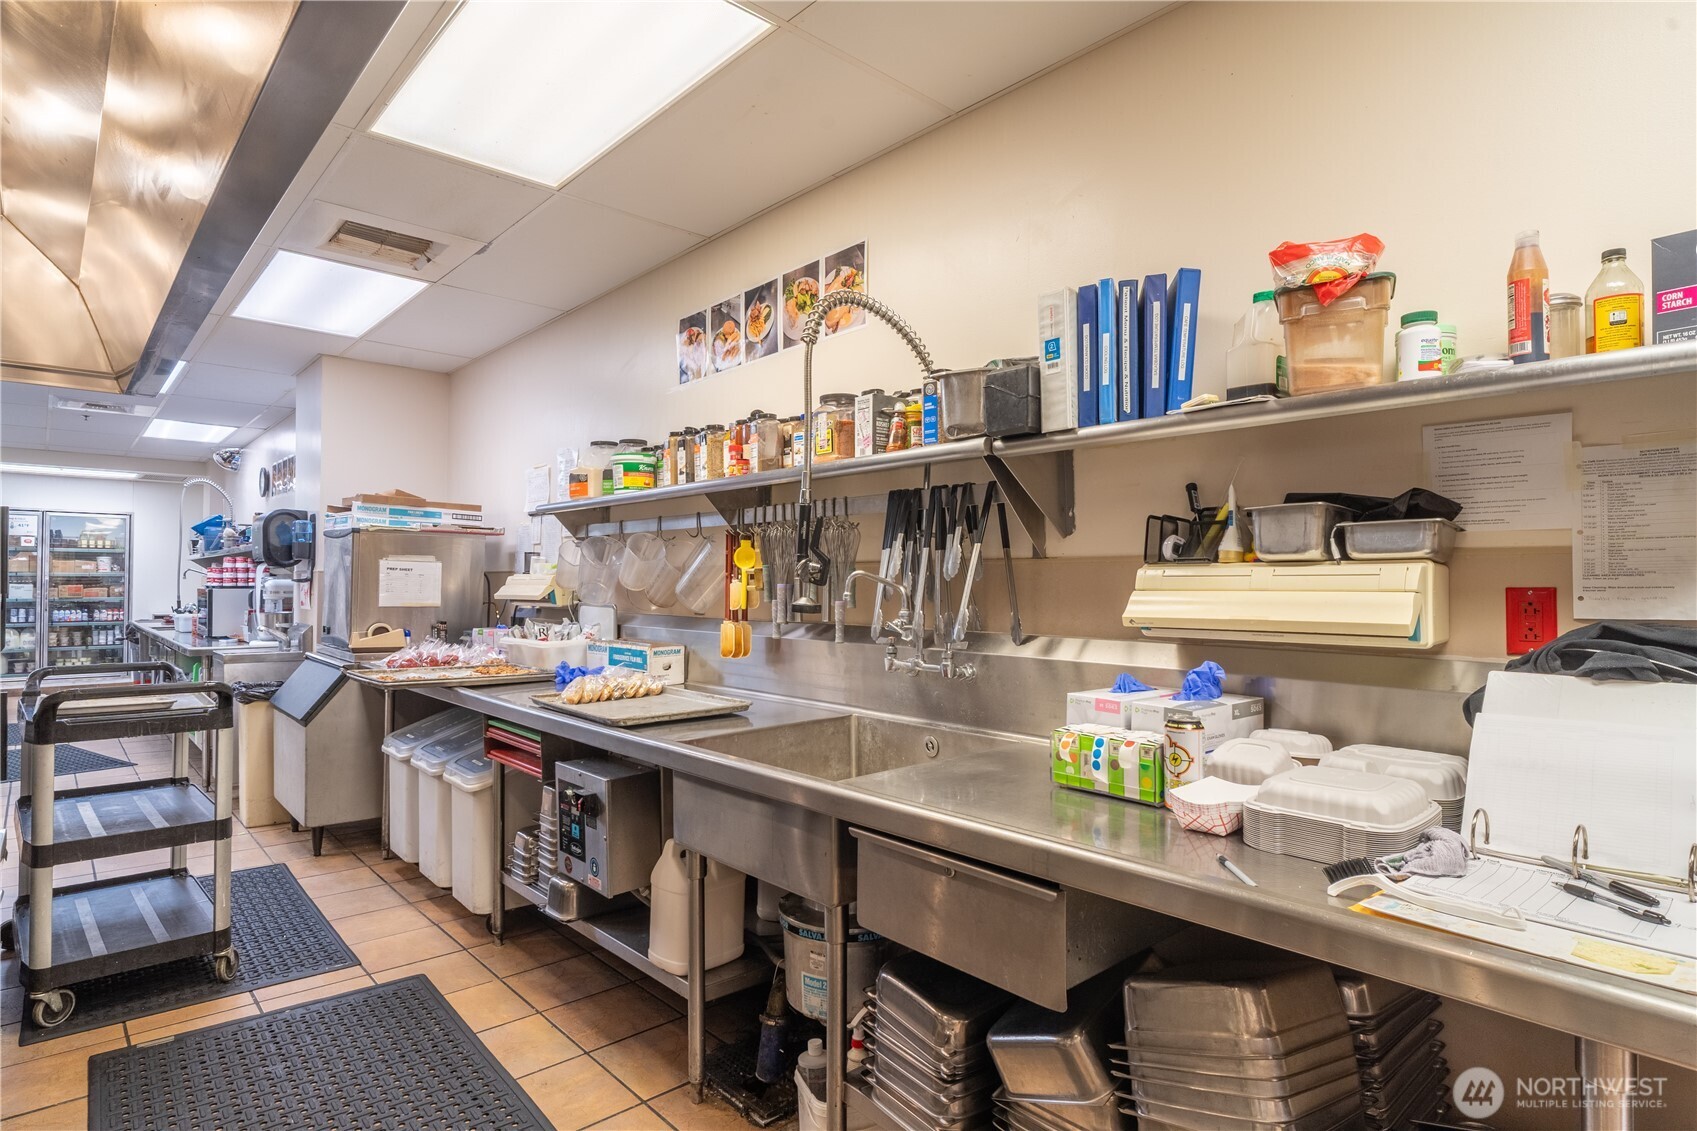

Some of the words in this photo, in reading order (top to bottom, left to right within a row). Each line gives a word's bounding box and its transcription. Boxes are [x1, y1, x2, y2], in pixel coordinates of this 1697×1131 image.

[1662, 292, 1683, 301] CORN
[1662, 298, 1692, 310] STARCH
[356, 505, 387, 513] MONOGRAM
[356, 517, 387, 525] MONOGRAM
[653, 648, 681, 656] MONOGRAM
[804, 976, 822, 988] Model
